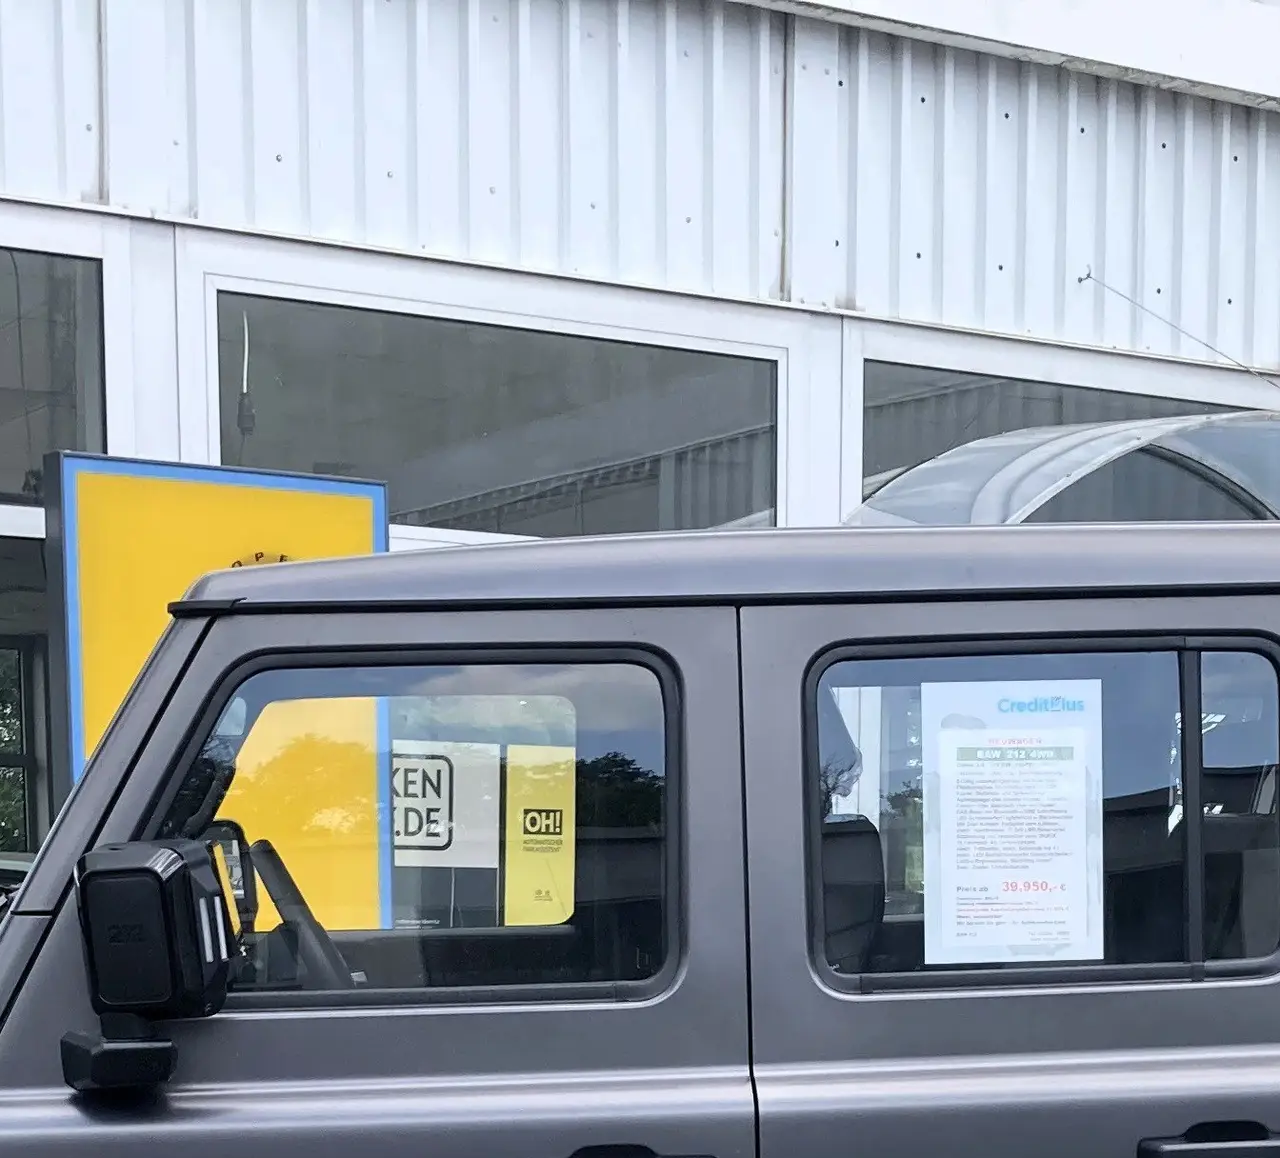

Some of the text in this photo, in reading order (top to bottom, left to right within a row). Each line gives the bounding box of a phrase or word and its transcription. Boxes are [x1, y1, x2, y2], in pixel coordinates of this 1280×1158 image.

[230, 551, 288, 568] OPE
[393, 807, 441, 837] .DE
[525, 811, 561, 833] OH!
